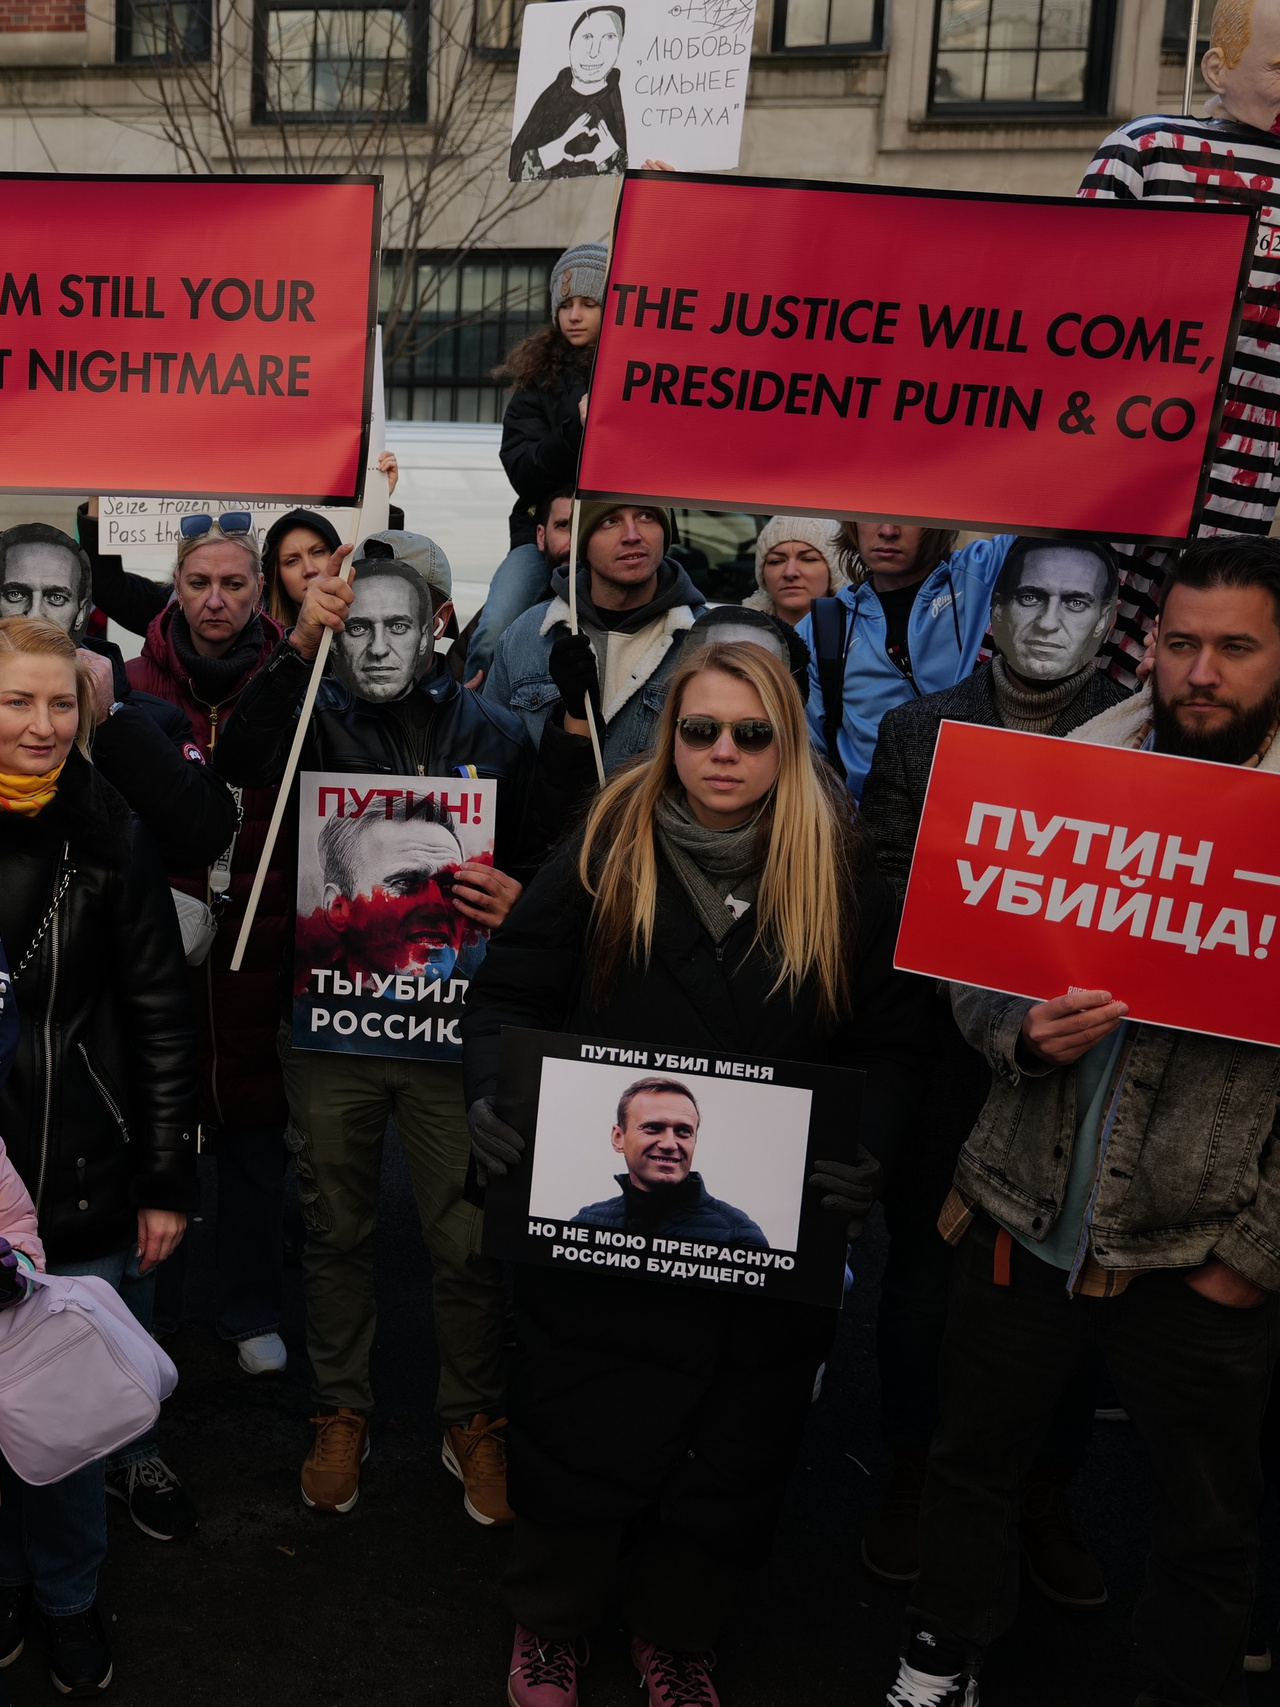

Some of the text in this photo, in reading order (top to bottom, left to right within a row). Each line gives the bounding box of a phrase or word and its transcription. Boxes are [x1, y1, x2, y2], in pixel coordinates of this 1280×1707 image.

[634, 69, 741, 96] СИЛЬНЕЕ
[58, 274, 165, 319] STILL
[180, 276, 316, 323] YOUR
[612, 283, 1216, 374] THE JUSTICE WILL COME,
[28, 349, 311, 397] NIGHTMARE
[621, 359, 1197, 443] PRESIDENT PUTIN & CO
[104, 497, 148, 514] Seize
[109, 520, 146, 543] Pass
[318, 786, 482, 825] ПУТИН!
[964, 801, 1214, 886] ПУТИН
[956, 859, 1277, 960] УБИЙЦА!
[311, 968, 362, 997] ТЫ
[581, 1044, 774, 1080] ПУТИН УБИЛ МЕНЯ
[528, 1222, 795, 1270] НО НЕ МОЮ ПРЕКРАСНУЮ
[552, 1244, 766, 1287] РОССИЮ БУДУЩЕГО!
